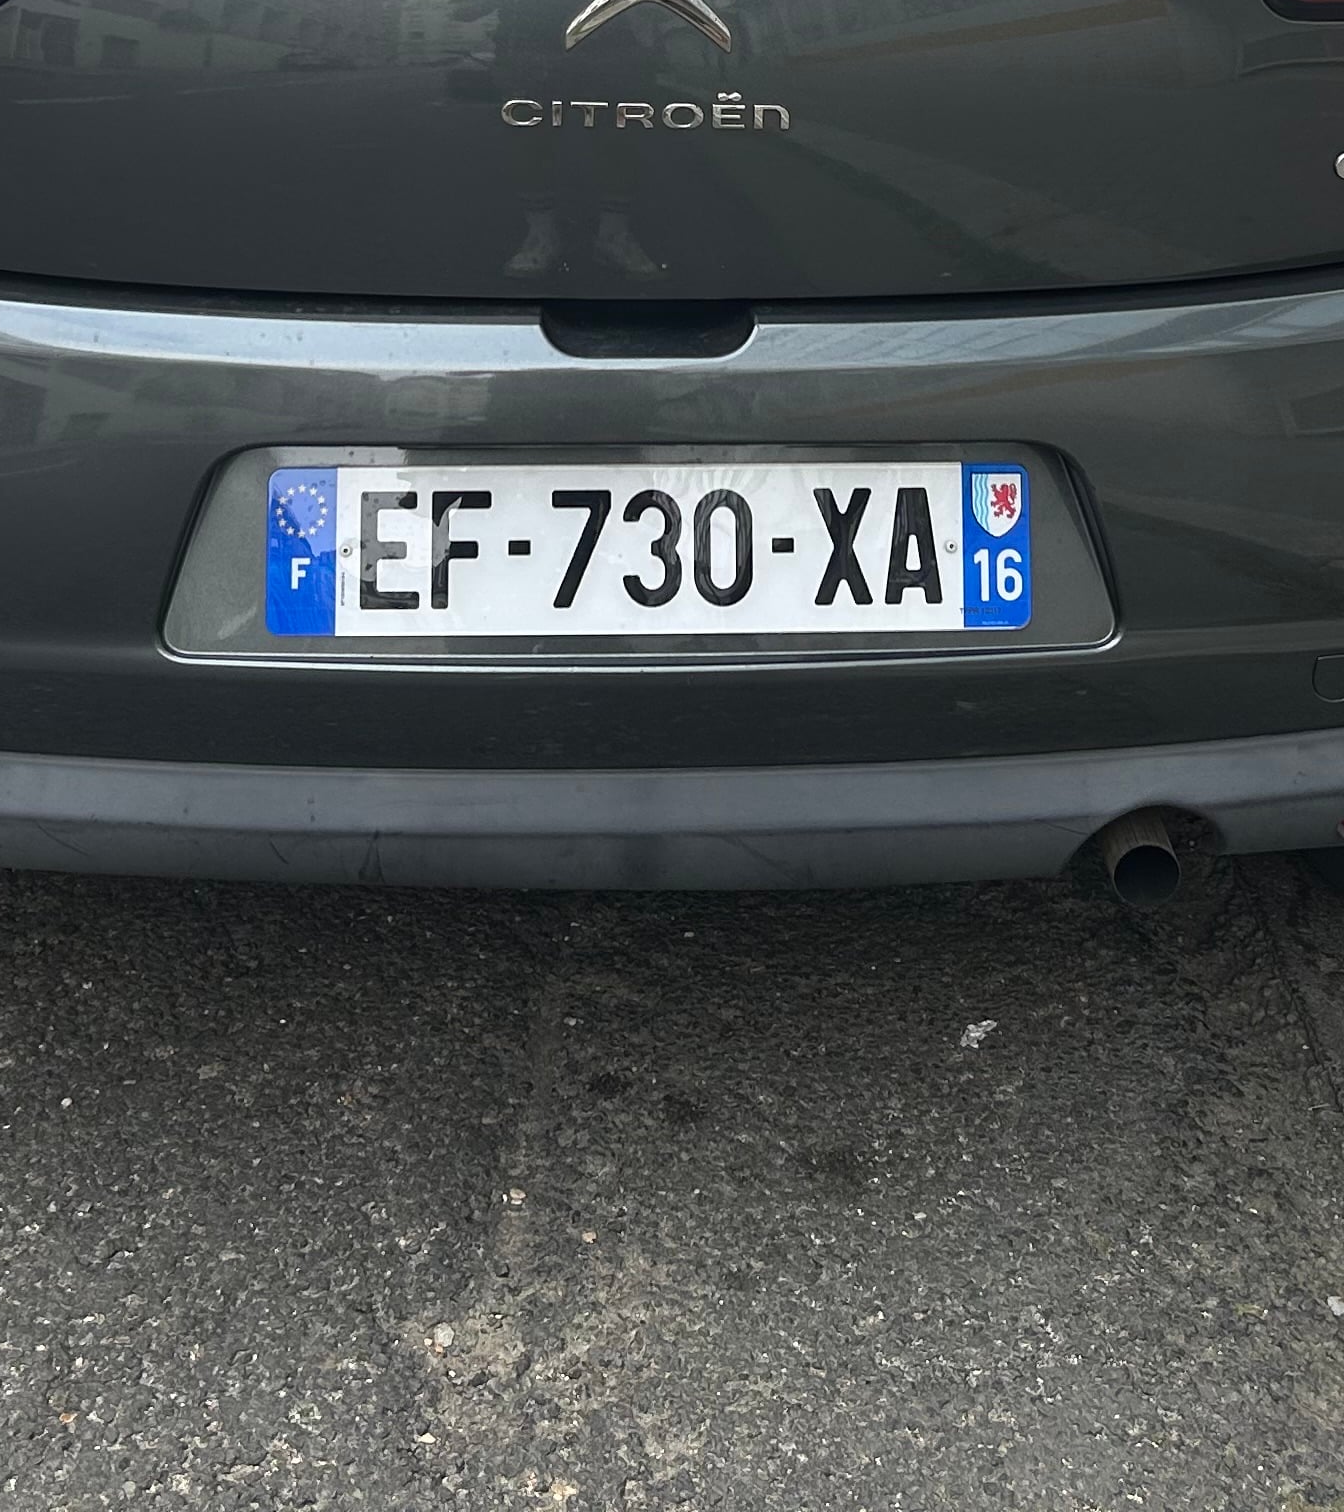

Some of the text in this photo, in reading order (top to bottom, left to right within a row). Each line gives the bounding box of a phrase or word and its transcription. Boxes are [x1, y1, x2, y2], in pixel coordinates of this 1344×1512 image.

[500, 91, 791, 130] CITROËN
[359, 488, 943, 610] EF-730-XA
[290, 557, 312, 590] F
[973, 548, 1024, 602] 16
